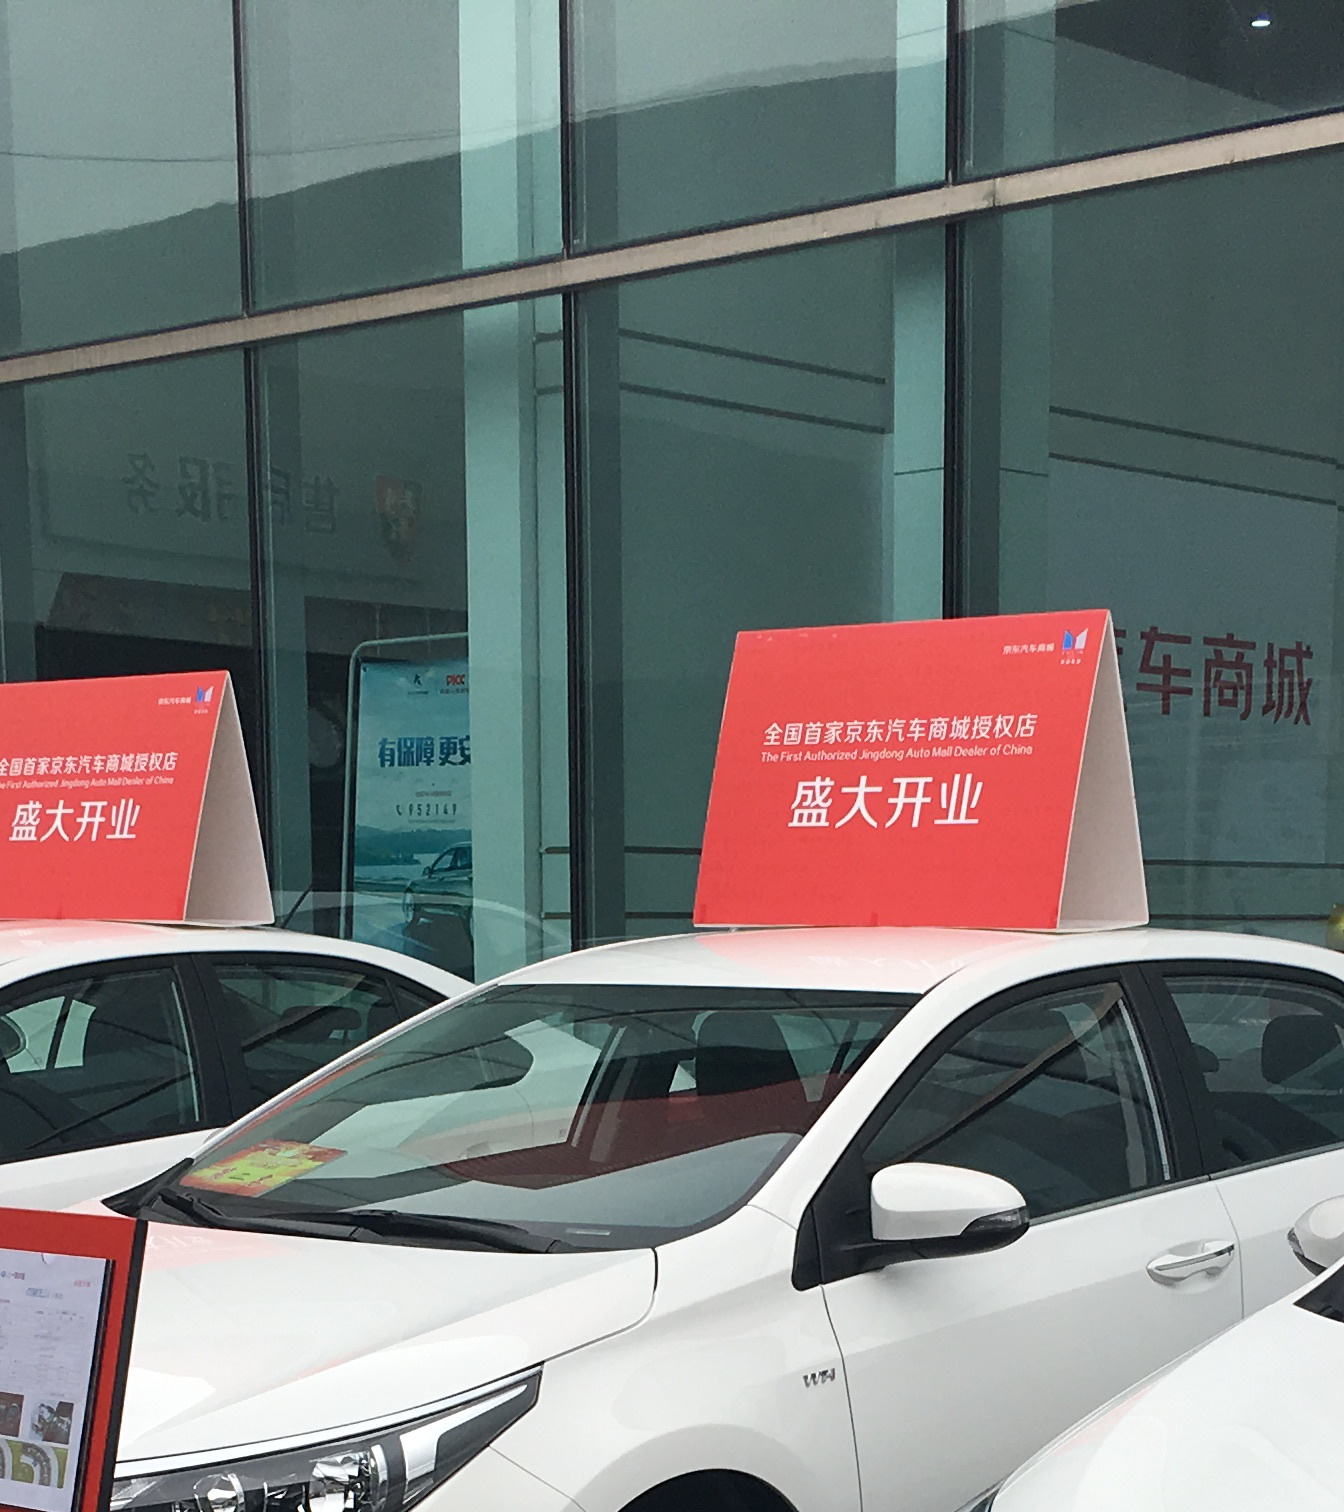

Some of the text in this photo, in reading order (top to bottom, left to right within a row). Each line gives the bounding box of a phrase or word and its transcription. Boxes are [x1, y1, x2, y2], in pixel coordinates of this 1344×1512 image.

[1114, 625, 1314, 726] 车商城
[764, 713, 1038, 746] 全国首家京东汽车商城授权店
[378, 736, 435, 767] 有保障
[760, 744, 1033, 762] The First Authorized Jingdong Auto Mall Dealer of China
[9, 798, 140, 842] 盛大开业
[788, 774, 983, 828] 盛大开业
